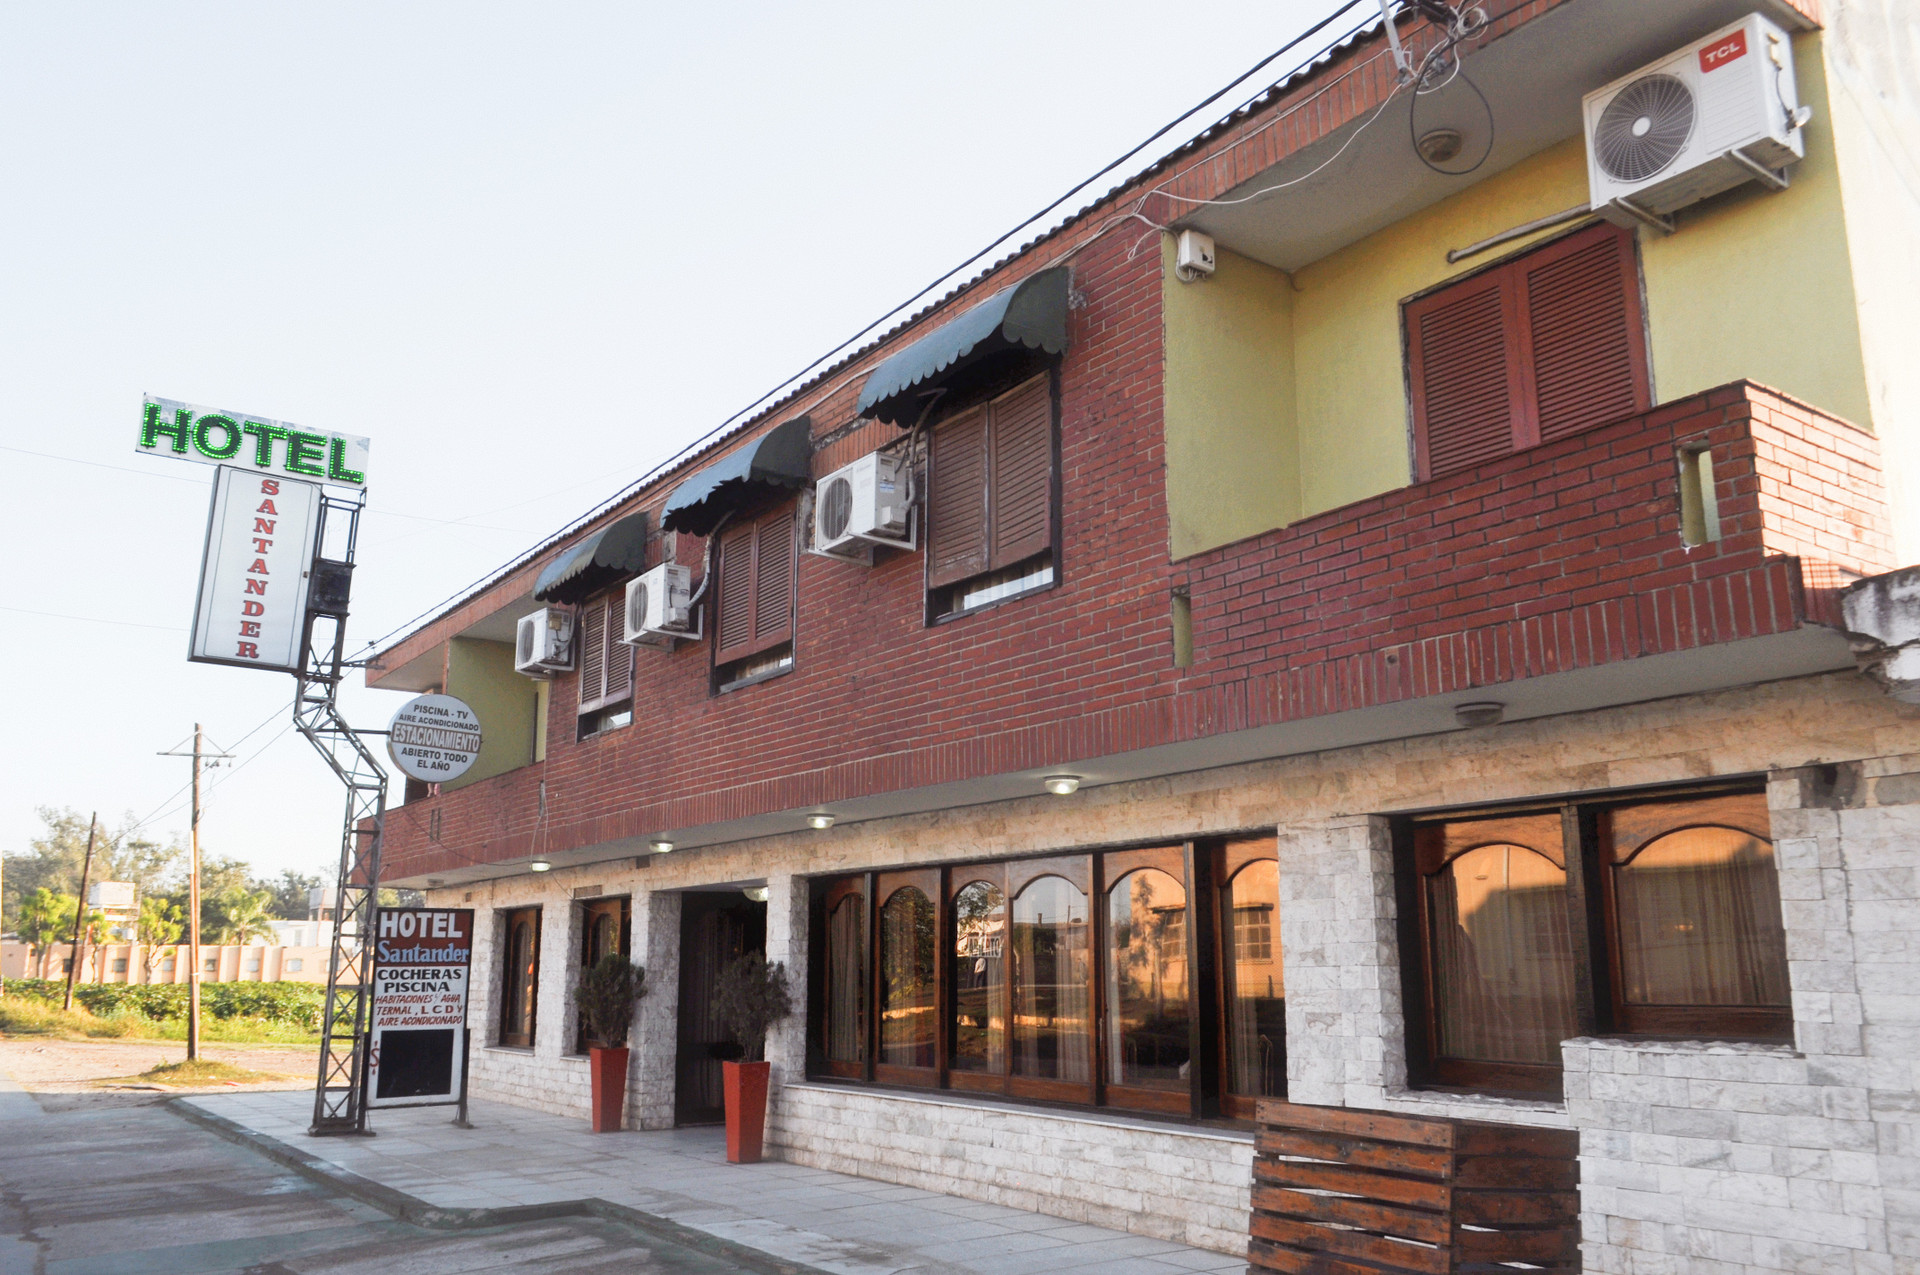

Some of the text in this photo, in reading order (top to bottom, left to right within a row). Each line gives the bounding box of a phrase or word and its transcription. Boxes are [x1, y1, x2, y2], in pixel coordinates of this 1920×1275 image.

[1704, 42, 1741, 63] TCL
[140, 402, 365, 484] HOTEL
[235, 478, 280, 659] SANTANDER
[413, 704, 449, 717] PISCINA
[456, 710, 469, 720] TV
[398, 713, 479, 732] AIRE ACONDICIONADO
[393, 724, 480, 752] ESTACIONAMIENTO
[401, 747, 468, 763] ABIERTO TODO
[417, 759, 450, 772] EL AÑO
[379, 911, 463, 938] HOTEL
[377, 939, 470, 963] Santander
[377, 968, 462, 980] COCHERAS
[384, 981, 450, 993] PISCINA
[374, 994, 433, 1004] HABITACIONES
[440, 994, 461, 1003] AGUA
[456, 1005, 463, 1013] Y
[377, 1015, 463, 1026] AIRE ACONDICIONADO
